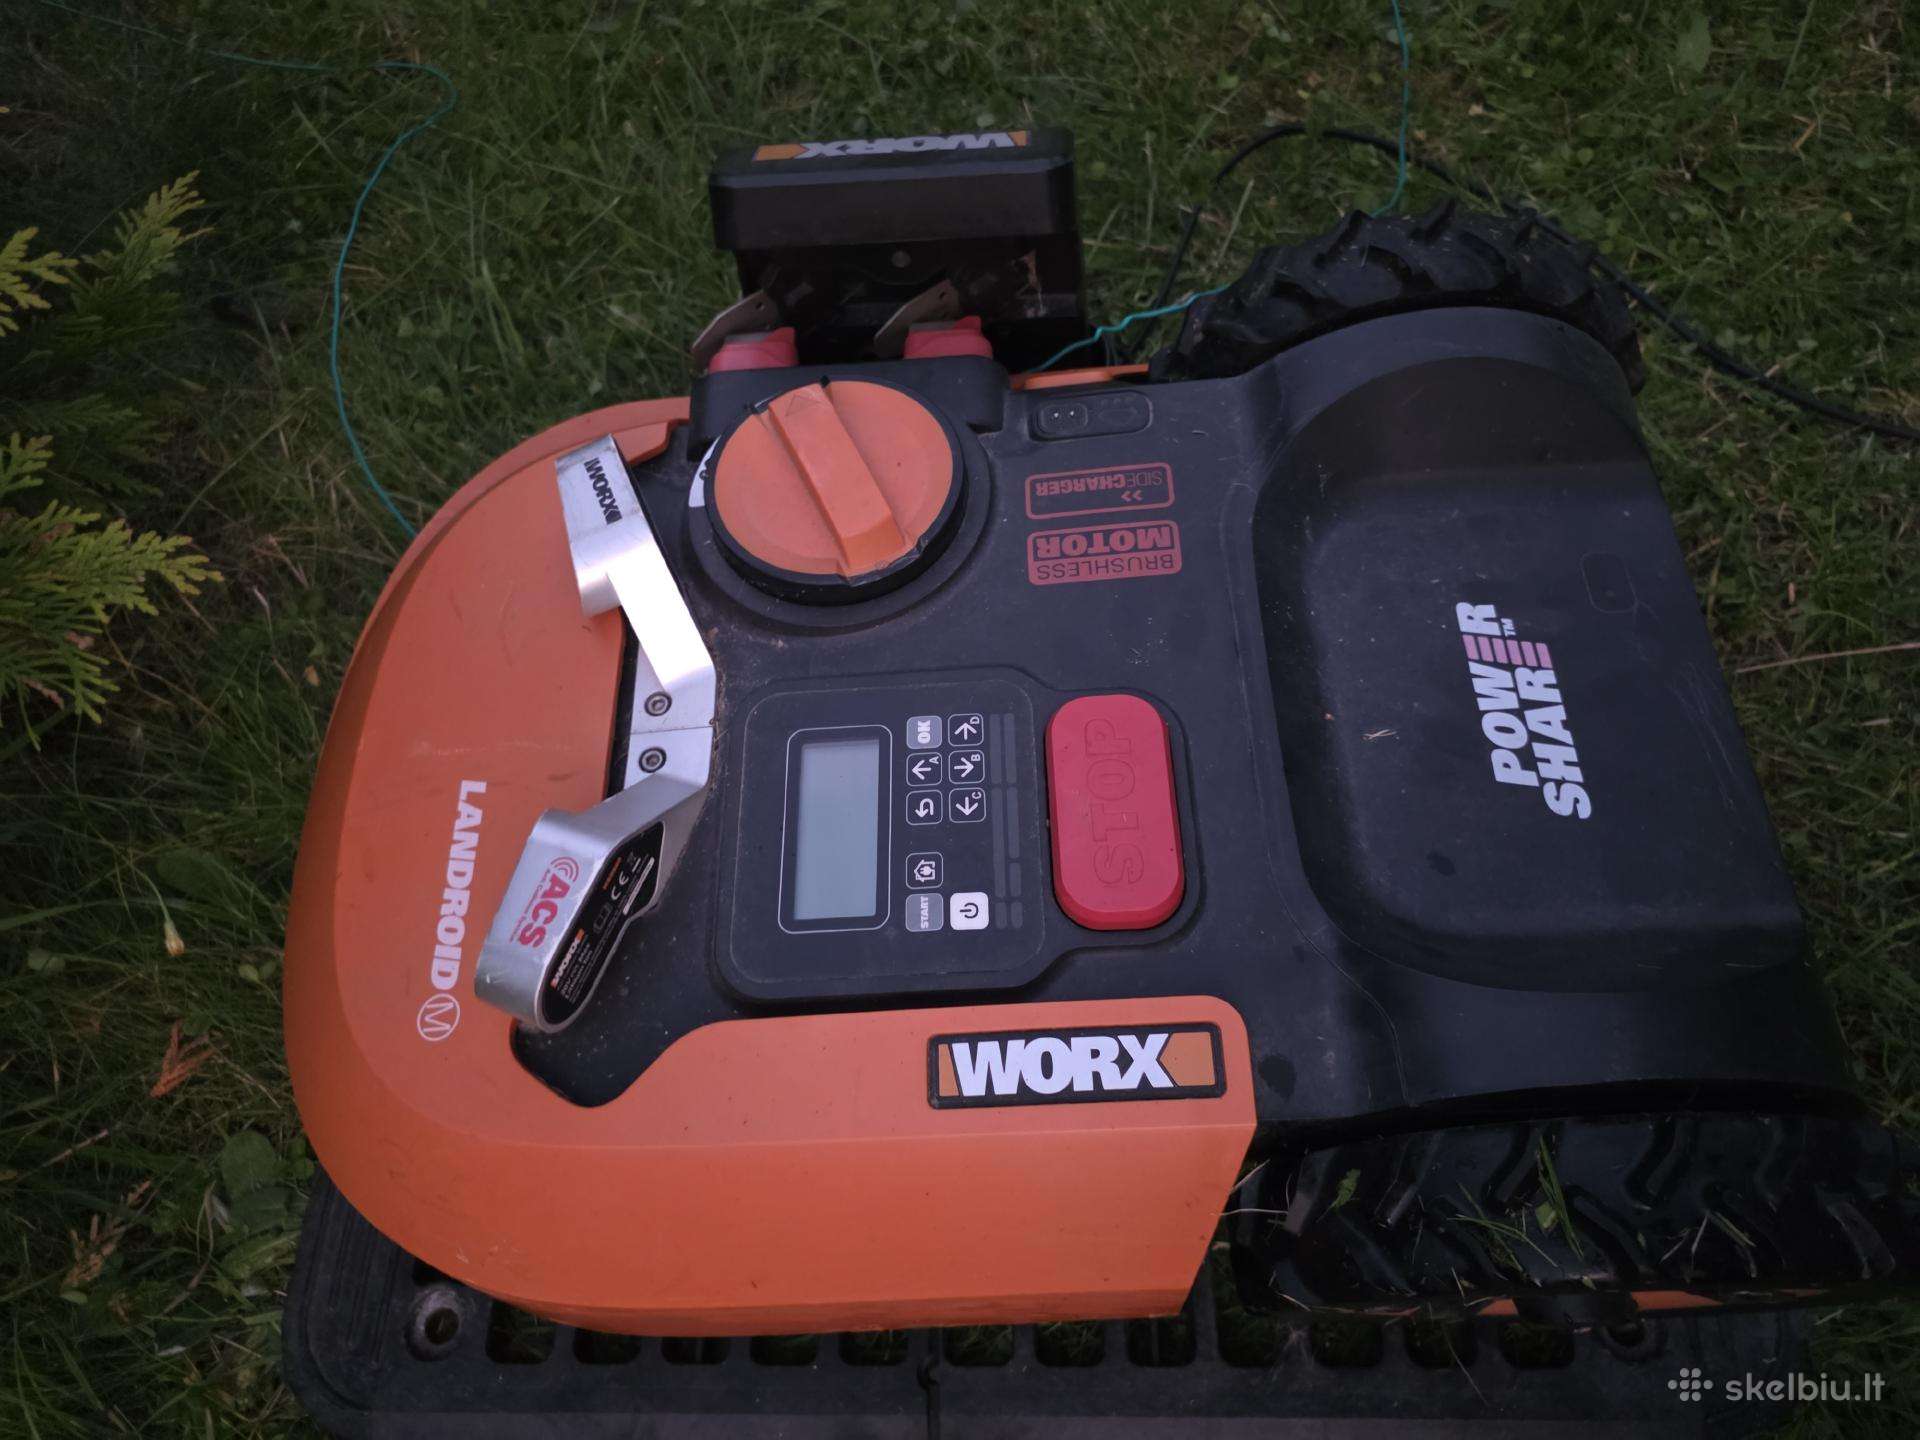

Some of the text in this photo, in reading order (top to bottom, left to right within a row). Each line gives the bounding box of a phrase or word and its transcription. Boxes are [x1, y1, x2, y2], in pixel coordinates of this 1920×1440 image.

[794, 132, 1014, 160] WORX
[586, 461, 619, 515] WORX
[1036, 527, 1172, 558] MOTOR
[1037, 554, 1174, 580] BRUSHLESS
[917, 720, 931, 744] OK
[969, 716, 980, 725] D
[929, 756, 940, 764] A
[970, 753, 981, 762] B
[971, 791, 982, 800] C
[1084, 719, 1144, 884] STOP
[430, 780, 487, 990] LANDROID
[519, 873, 570, 948] ACS
[920, 896, 930, 928] START
[952, 1033, 1175, 1097] WORX
